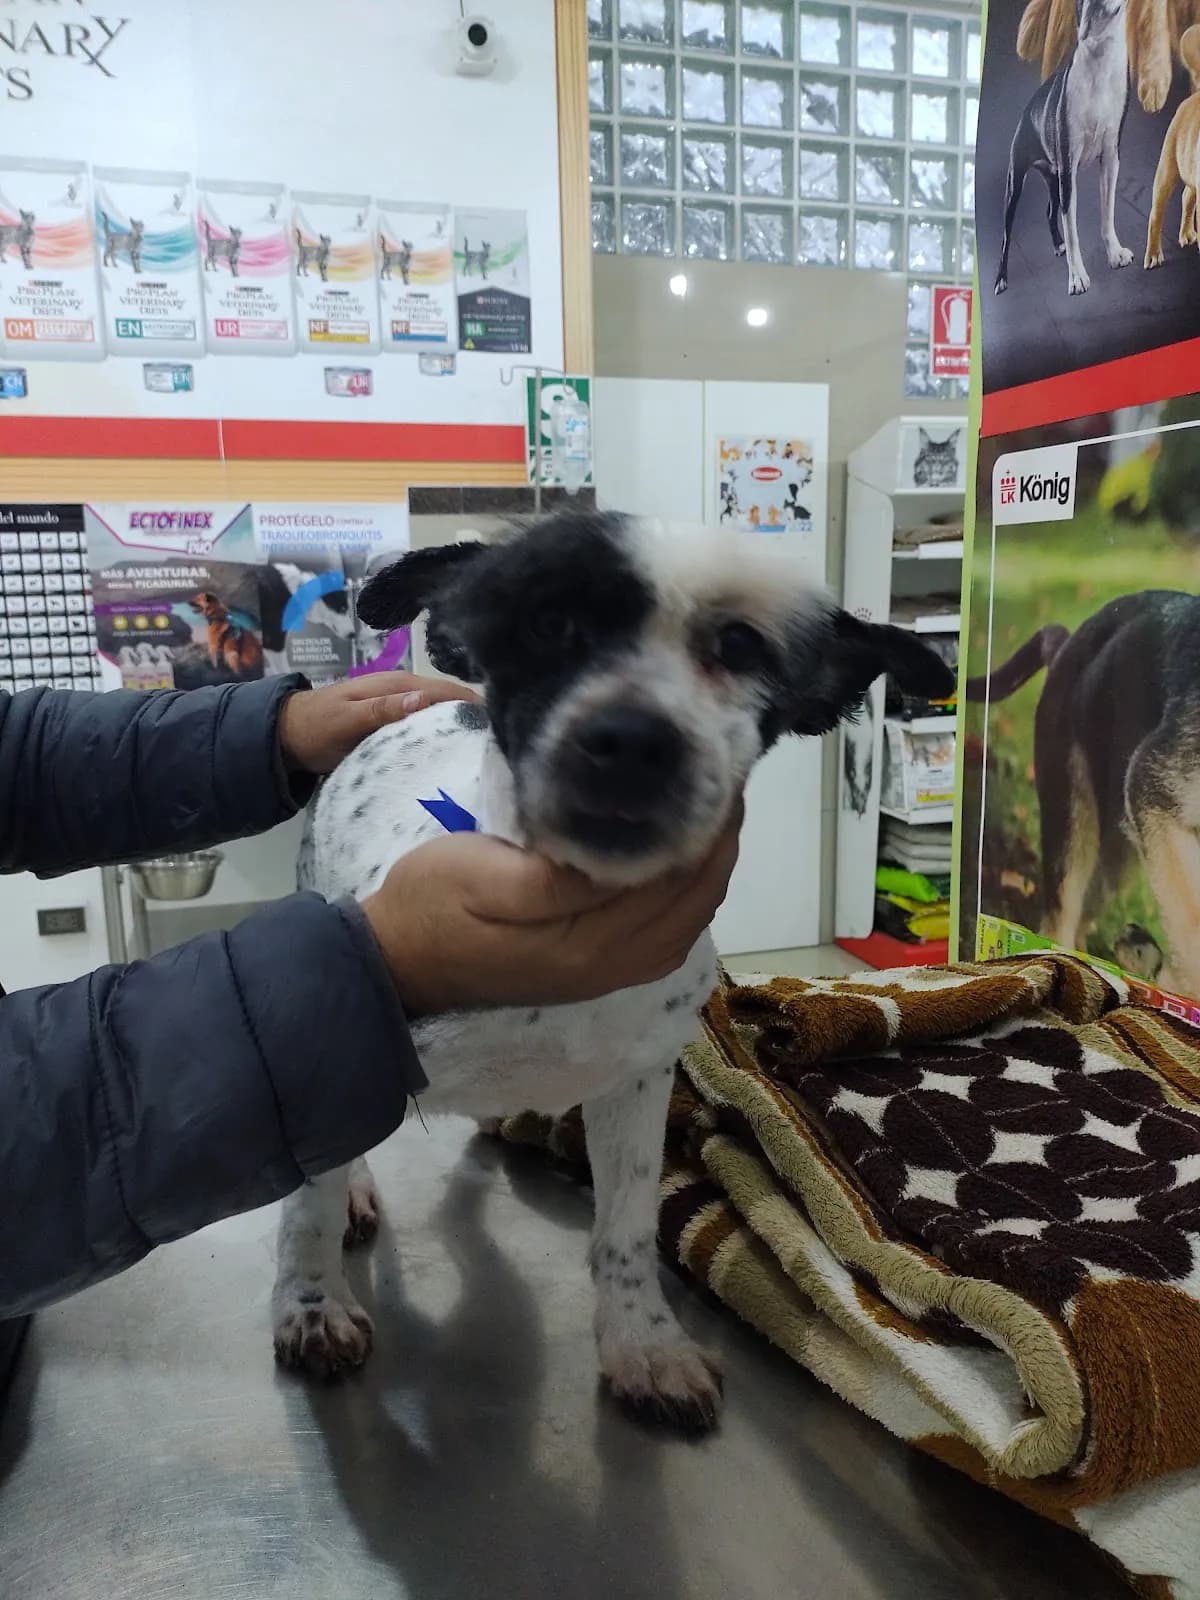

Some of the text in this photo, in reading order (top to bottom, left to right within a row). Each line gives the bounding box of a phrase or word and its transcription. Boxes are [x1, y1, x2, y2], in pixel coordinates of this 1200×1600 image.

[7, 321, 34, 338] OM
[118, 321, 141, 336] EN
[217, 320, 239, 336] UR
[1001, 472, 1070, 505] LK König
[17, 511, 60, 524] mundo
[259, 512, 335, 526] PROTÉGELO
[126, 566, 211, 580] AVENTURAS,
[134, 579, 199, 589] PICADURAS.
